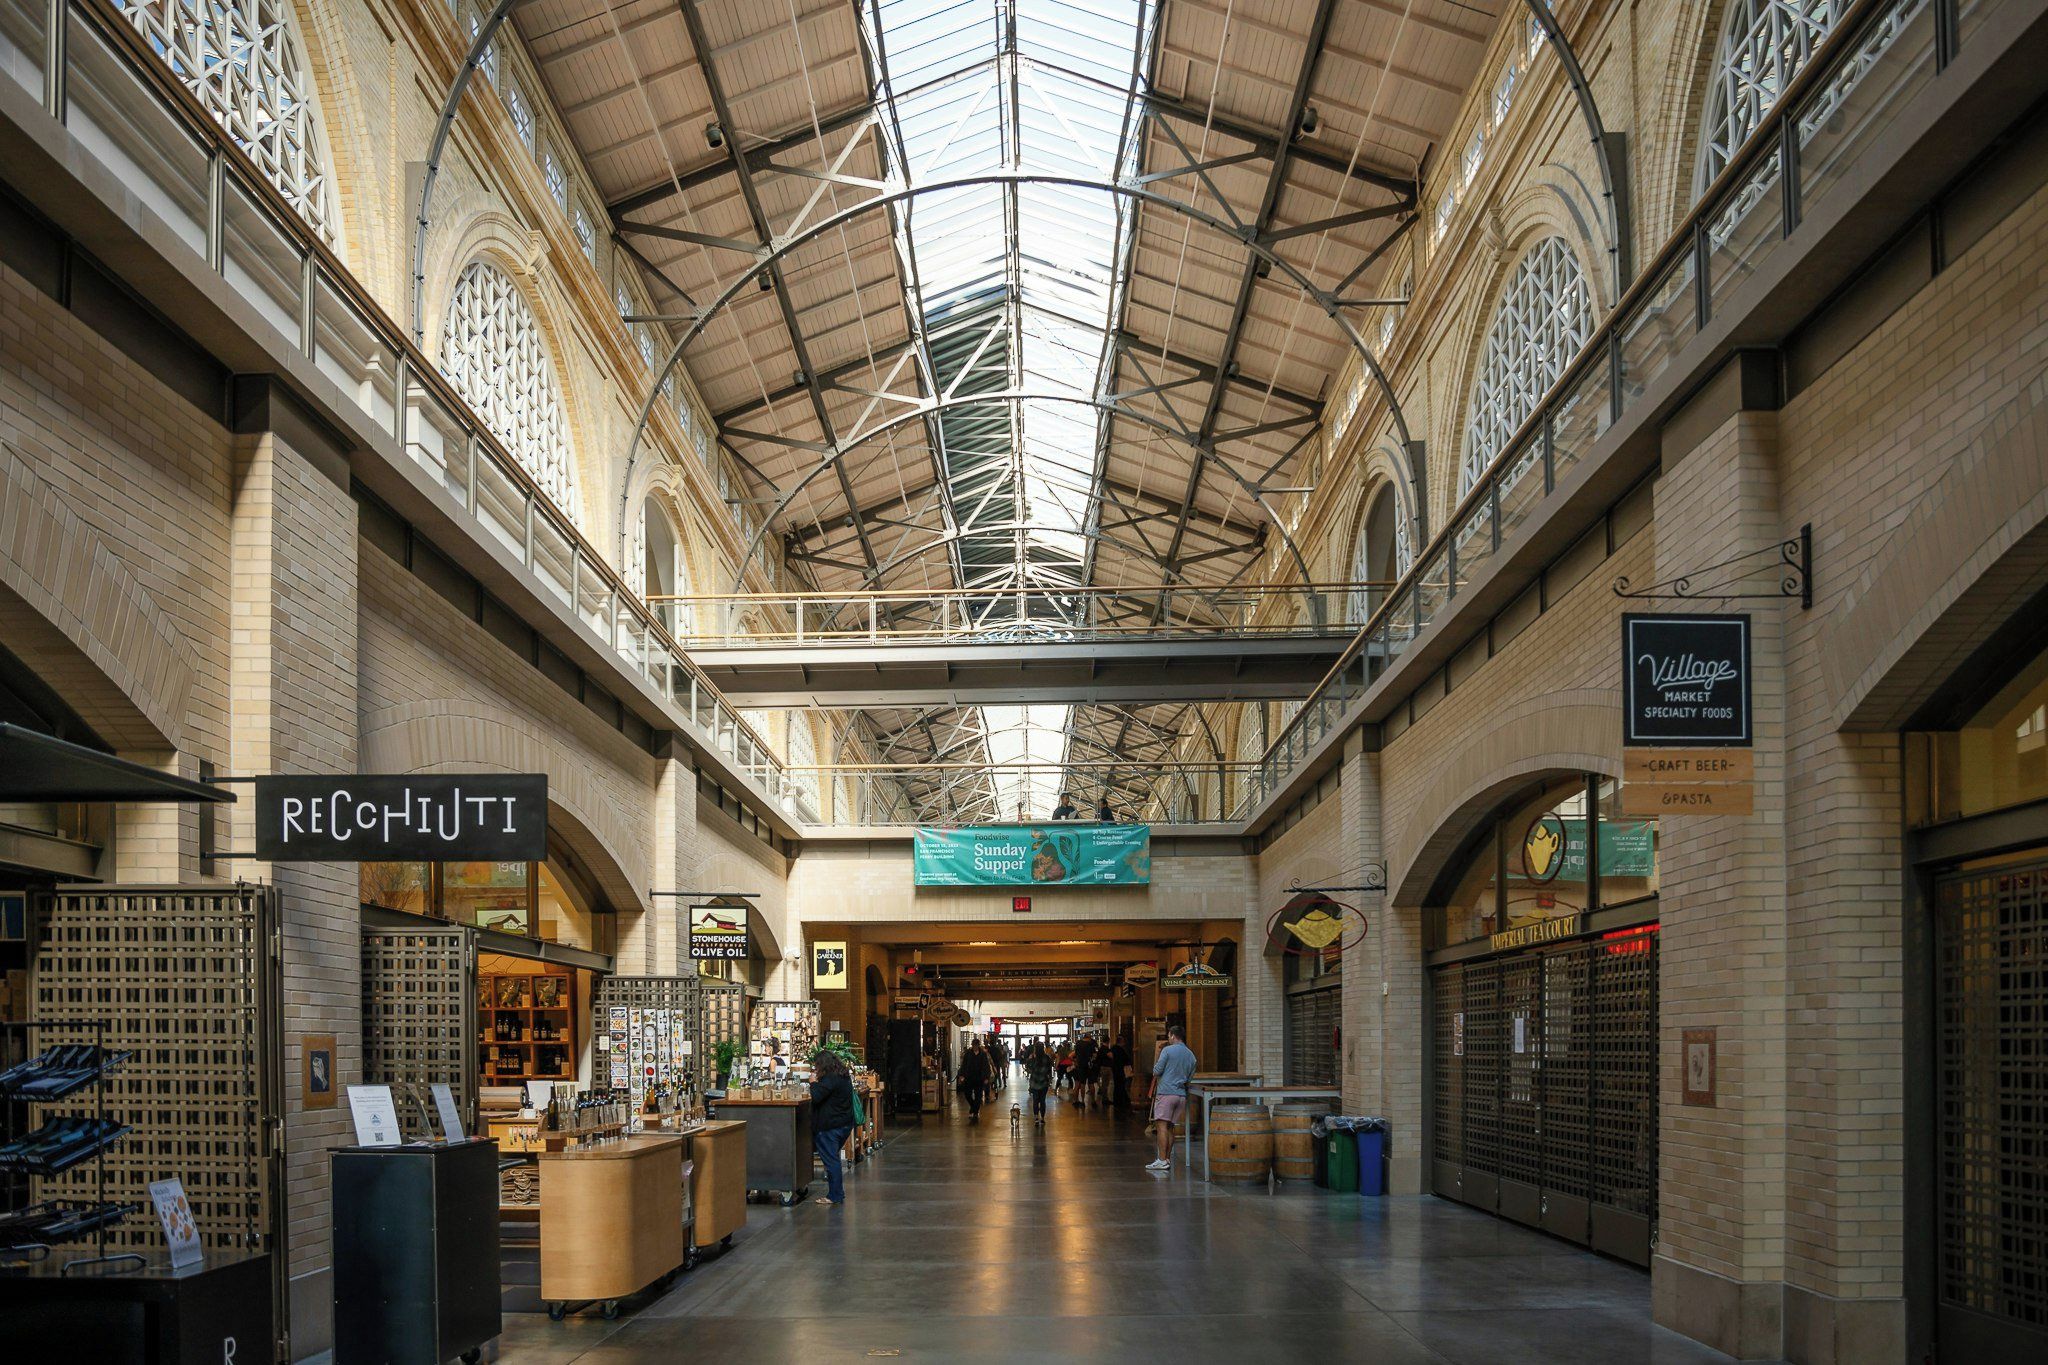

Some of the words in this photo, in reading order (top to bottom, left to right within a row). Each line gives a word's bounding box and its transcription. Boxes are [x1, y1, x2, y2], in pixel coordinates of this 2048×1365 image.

[1638, 653, 1738, 691] Village
[1664, 691, 1711, 702] MARKET
[1644, 706, 1698, 719] SPECIALTY
[1702, 707, 1733, 719] FOODS
[1662, 793, 1712, 805] &PASTA
[283, 788, 517, 843] RECCHIUTI
[974, 842, 1027, 860] Sunday
[974, 857, 1026, 874] Supper
[691, 935, 747, 943] STONEHOUSE
[1491, 929, 1526, 951] IMPERIAL
[1528, 925, 1544, 943] TEA
[1546, 916, 1575, 939] COURT
[691, 947, 724, 957] OLIVE
[726, 947, 747, 957] OIL
